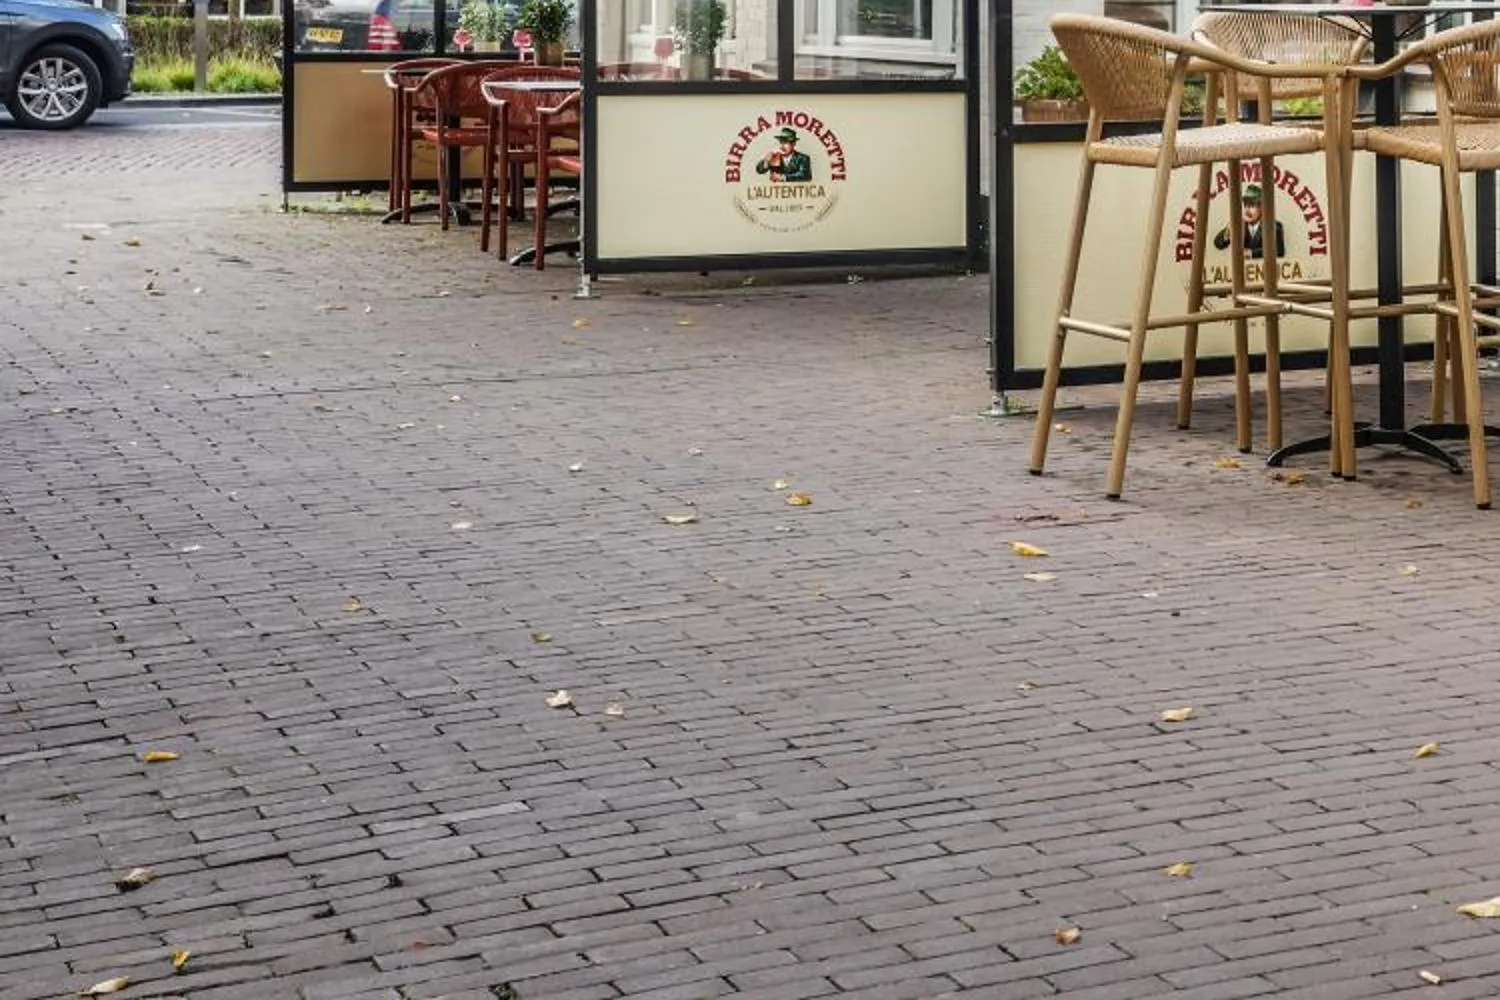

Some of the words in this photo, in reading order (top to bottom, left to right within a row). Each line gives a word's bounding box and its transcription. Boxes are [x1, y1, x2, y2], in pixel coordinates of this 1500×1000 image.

[725, 116, 772, 183] BIRRA
[776, 111, 847, 181] MORETTI
[747, 185, 826, 200] L'AUTENTICA
